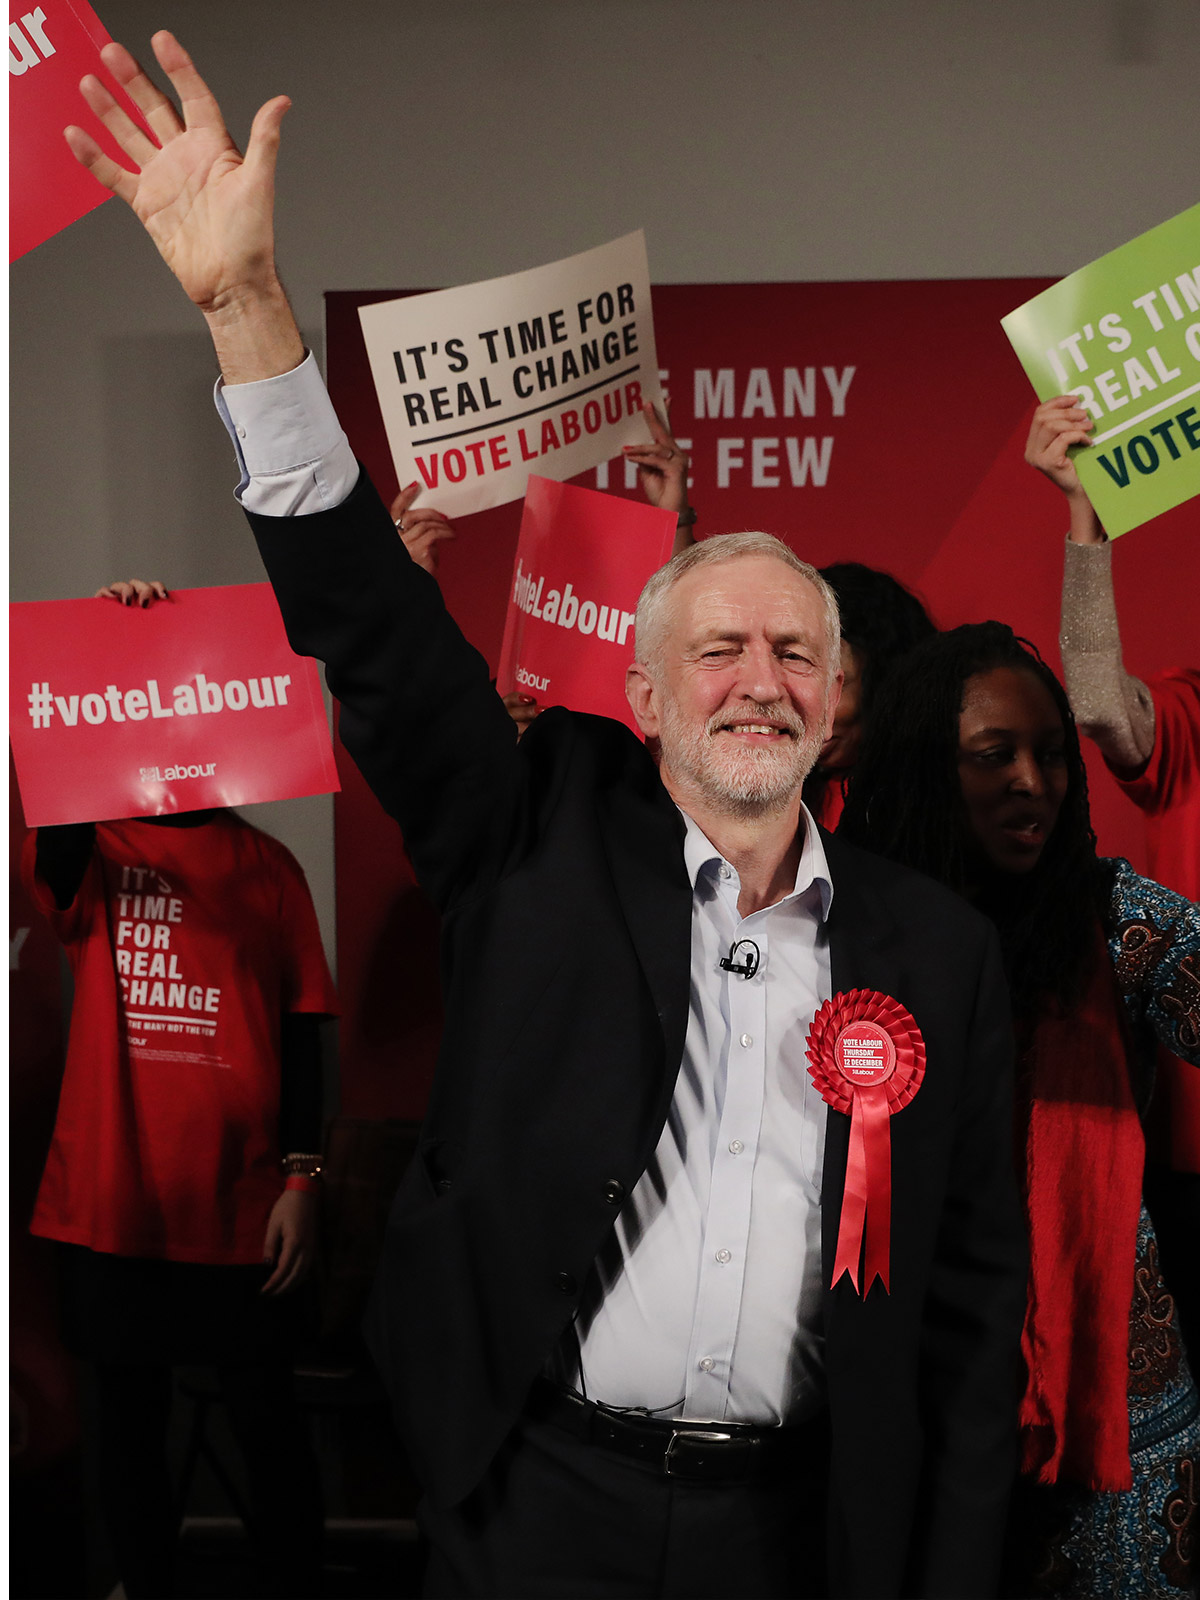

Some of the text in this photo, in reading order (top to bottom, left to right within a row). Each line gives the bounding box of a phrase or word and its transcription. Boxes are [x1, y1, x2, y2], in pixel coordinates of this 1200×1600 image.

[393, 283, 635, 384] IT'S TIME FOR
[1046, 313, 1131, 383] IT'S
[403, 377, 501, 427] REAL
[512, 322, 639, 399] CHANGE
[694, 366, 856, 419] MANY
[1065, 346, 1181, 419] REAL
[414, 434, 511, 489] VOTE
[517, 380, 643, 462] LABOUR
[1096, 406, 1200, 488] VOTE
[717, 436, 834, 488] FEW
[28, 673, 291, 729] #voteLabour
[155, 763, 216, 782] Labour
[118, 894, 183, 922] TIME
[117, 921, 170, 949] FOR
[116, 949, 182, 979] REAL
[143, 1022, 166, 1031] MANY
[167, 1023, 184, 1033] NOT
[186, 1025, 200, 1035] THE
[843, 1049, 874, 1057] THURSDAY
[859, 1039, 883, 1047] LABOUR
[851, 1059, 883, 1067] DECEMBER
